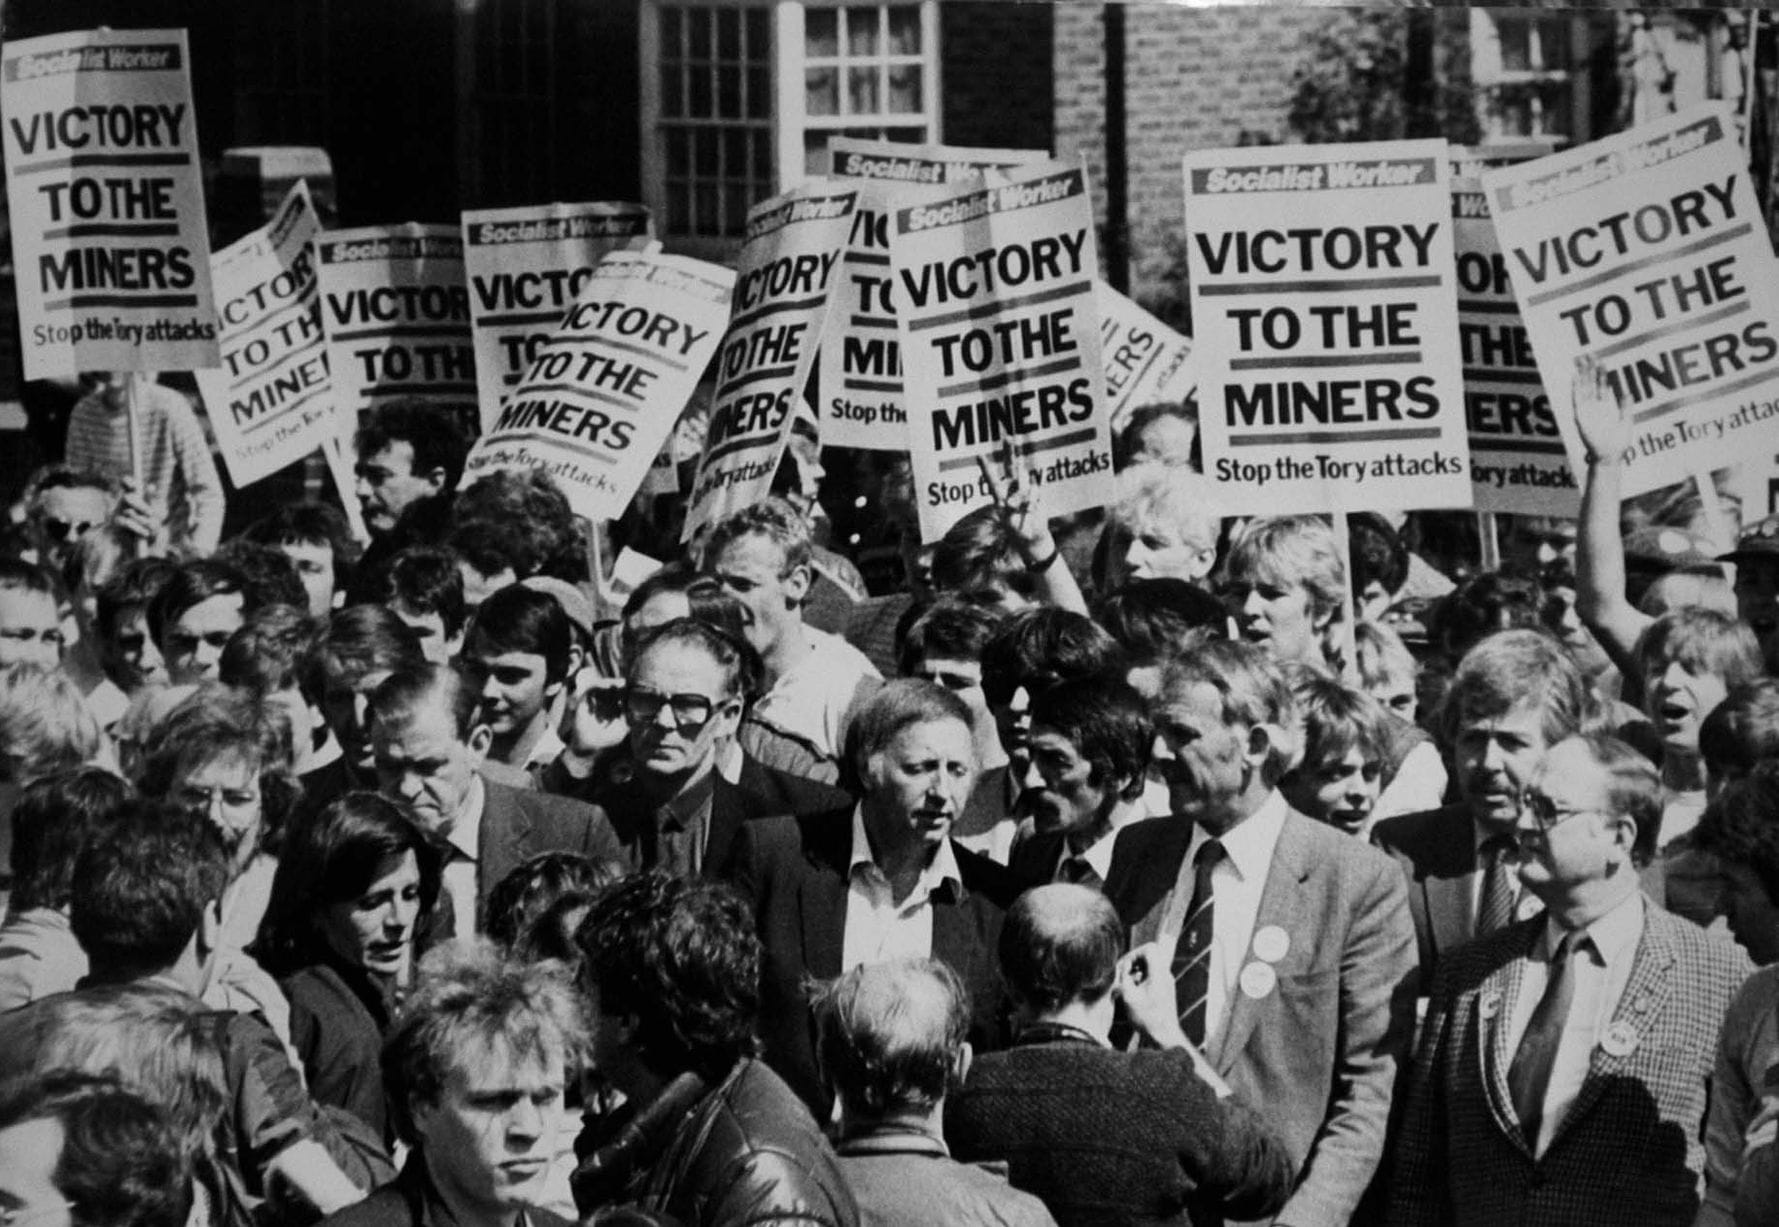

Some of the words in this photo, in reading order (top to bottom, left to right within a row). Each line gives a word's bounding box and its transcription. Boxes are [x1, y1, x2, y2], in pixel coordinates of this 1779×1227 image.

[10, 103, 186, 155] VICTORY
[846, 154, 943, 183] Socialist
[1206, 166, 1324, 193] Socialist
[1328, 160, 1424, 189] Worker
[38, 177, 101, 222] TO
[104, 177, 177, 219] THE
[908, 195, 997, 231] Socialist
[1001, 178, 1073, 212] Worker
[480, 219, 566, 243] Socialist
[1195, 222, 1440, 275] VICTORY
[1513, 174, 1737, 284] VICTORY
[39, 246, 195, 293] MINERS
[900, 229, 1087, 308] VICTORY
[327, 285, 470, 325] VICTOR
[1560, 294, 1631, 346] TO
[1634, 255, 1746, 320] THE
[33, 322, 83, 346] Stop
[145, 317, 216, 342] attacks
[224, 339, 270, 377] TO
[271, 300, 325, 347] TH
[561, 301, 709, 355] ICTORY
[746, 322, 808, 369] THE
[931, 328, 993, 377] TO
[993, 307, 1078, 364] THE
[1227, 306, 1300, 351] TO
[1309, 302, 1421, 349] THE
[230, 349, 331, 426] MINE
[354, 345, 411, 382] TO
[414, 345, 476, 381] TH
[529, 351, 573, 382] TO
[576, 352, 658, 401] THE
[494, 399, 637, 450] MINERS
[831, 398, 876, 425] Stop
[931, 378, 1094, 451] MINERS
[1224, 375, 1440, 427] MINERS
[1465, 392, 1560, 437] ERS
[1639, 431, 1677, 457] the
[1674, 420, 1725, 443] Tory
[928, 482, 974, 506] Stop
[1046, 450, 1110, 483] attacks
[1216, 456, 1271, 485] Stop
[1275, 455, 1314, 480] the
[1315, 454, 1367, 484] Tory
[1371, 451, 1463, 478] attacks
[1509, 463, 1578, 488] attack
